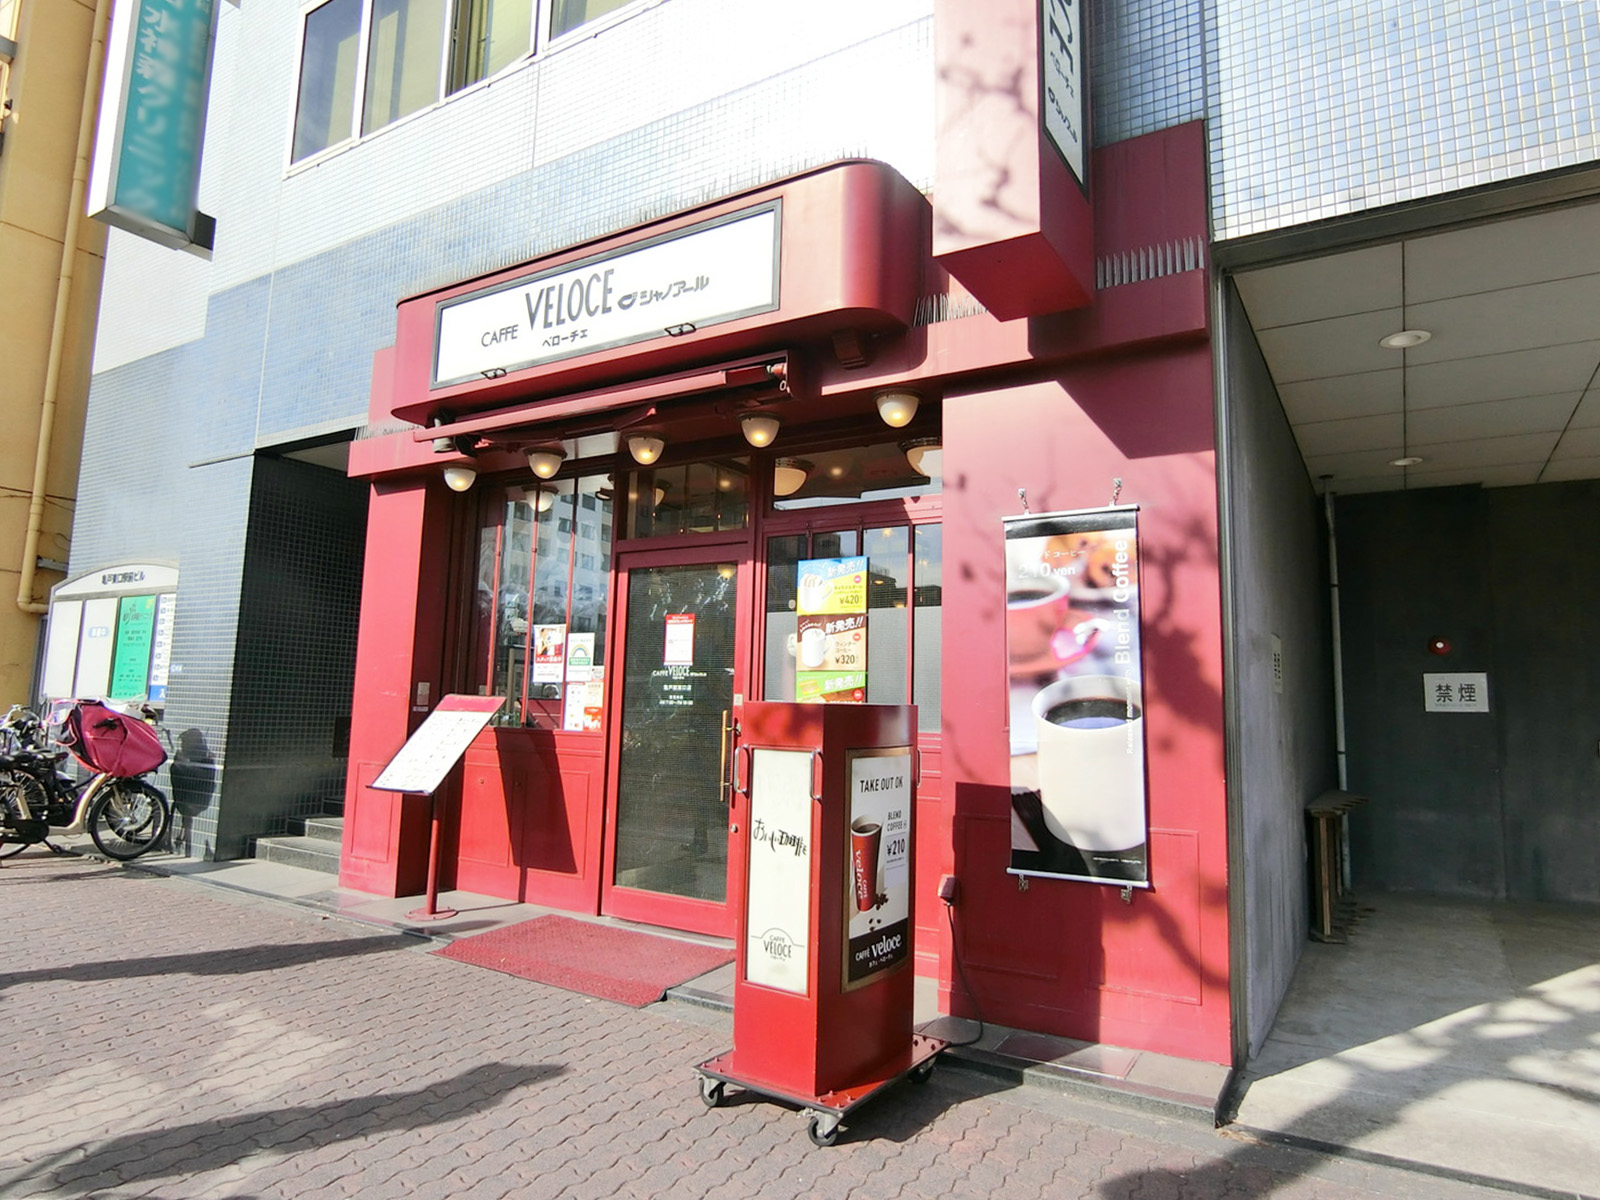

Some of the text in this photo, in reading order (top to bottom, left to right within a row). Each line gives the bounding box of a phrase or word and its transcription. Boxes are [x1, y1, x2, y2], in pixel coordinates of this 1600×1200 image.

[640, 275, 710, 306] シャノアール
[481, 268, 615, 348] CAFFE VELOCE
[542, 329, 588, 347] ベローチェ
[1112, 540, 1131, 665] Blend Coffee
[825, 615, 864, 633] 新発売!!
[835, 654, 855, 664] ¥320
[1435, 683, 1476, 702] 禁煙
[860, 776, 903, 793] TAKE OUT OK
[888, 810, 901, 820] BLEND
[887, 821, 902, 832] COFFEE
[887, 838, 905, 856] ¥210
[763, 940, 792, 958] VELOCE
